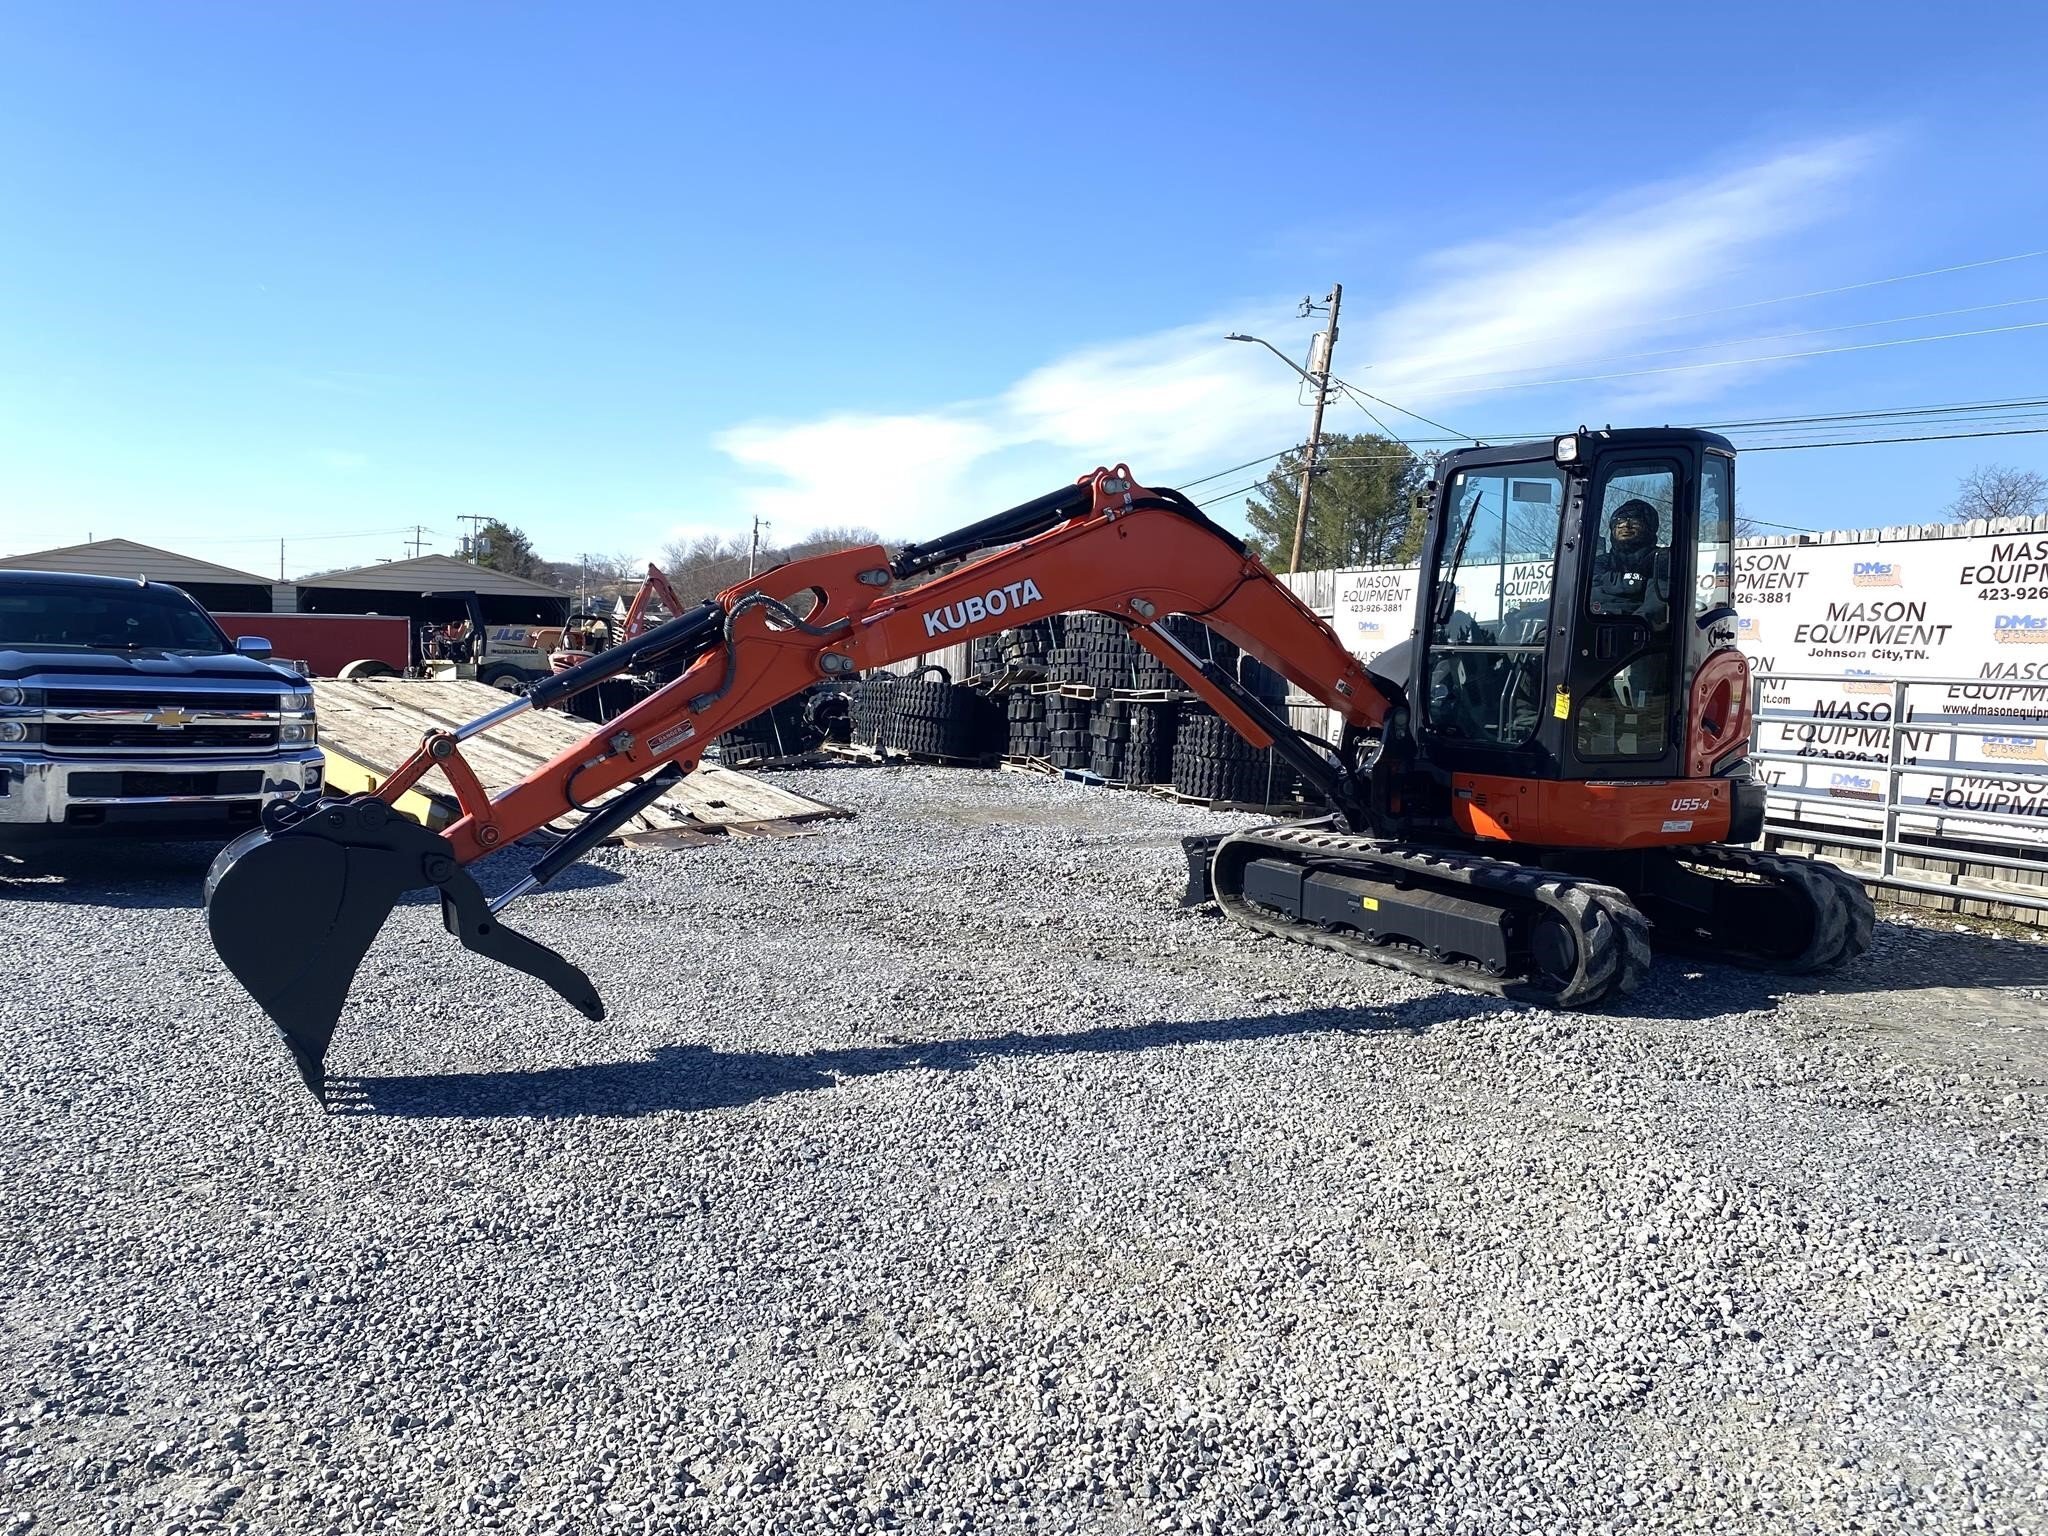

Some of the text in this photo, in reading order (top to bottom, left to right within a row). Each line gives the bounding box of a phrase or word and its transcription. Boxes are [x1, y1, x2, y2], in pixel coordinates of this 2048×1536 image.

[1356, 575, 1401, 588] MASON
[1342, 588, 1412, 602] EQUIPMENT
[1736, 592, 1791, 604] 26-3881
[922, 578, 1043, 637] KUBOTA
[1350, 603, 1403, 613] 423-926-3881
[1826, 601, 1927, 622] MASON
[491, 628, 527, 641] JLG
[1794, 623, 1953, 646] EQUIPMENT
[1808, 648, 1867, 658] Johnson
